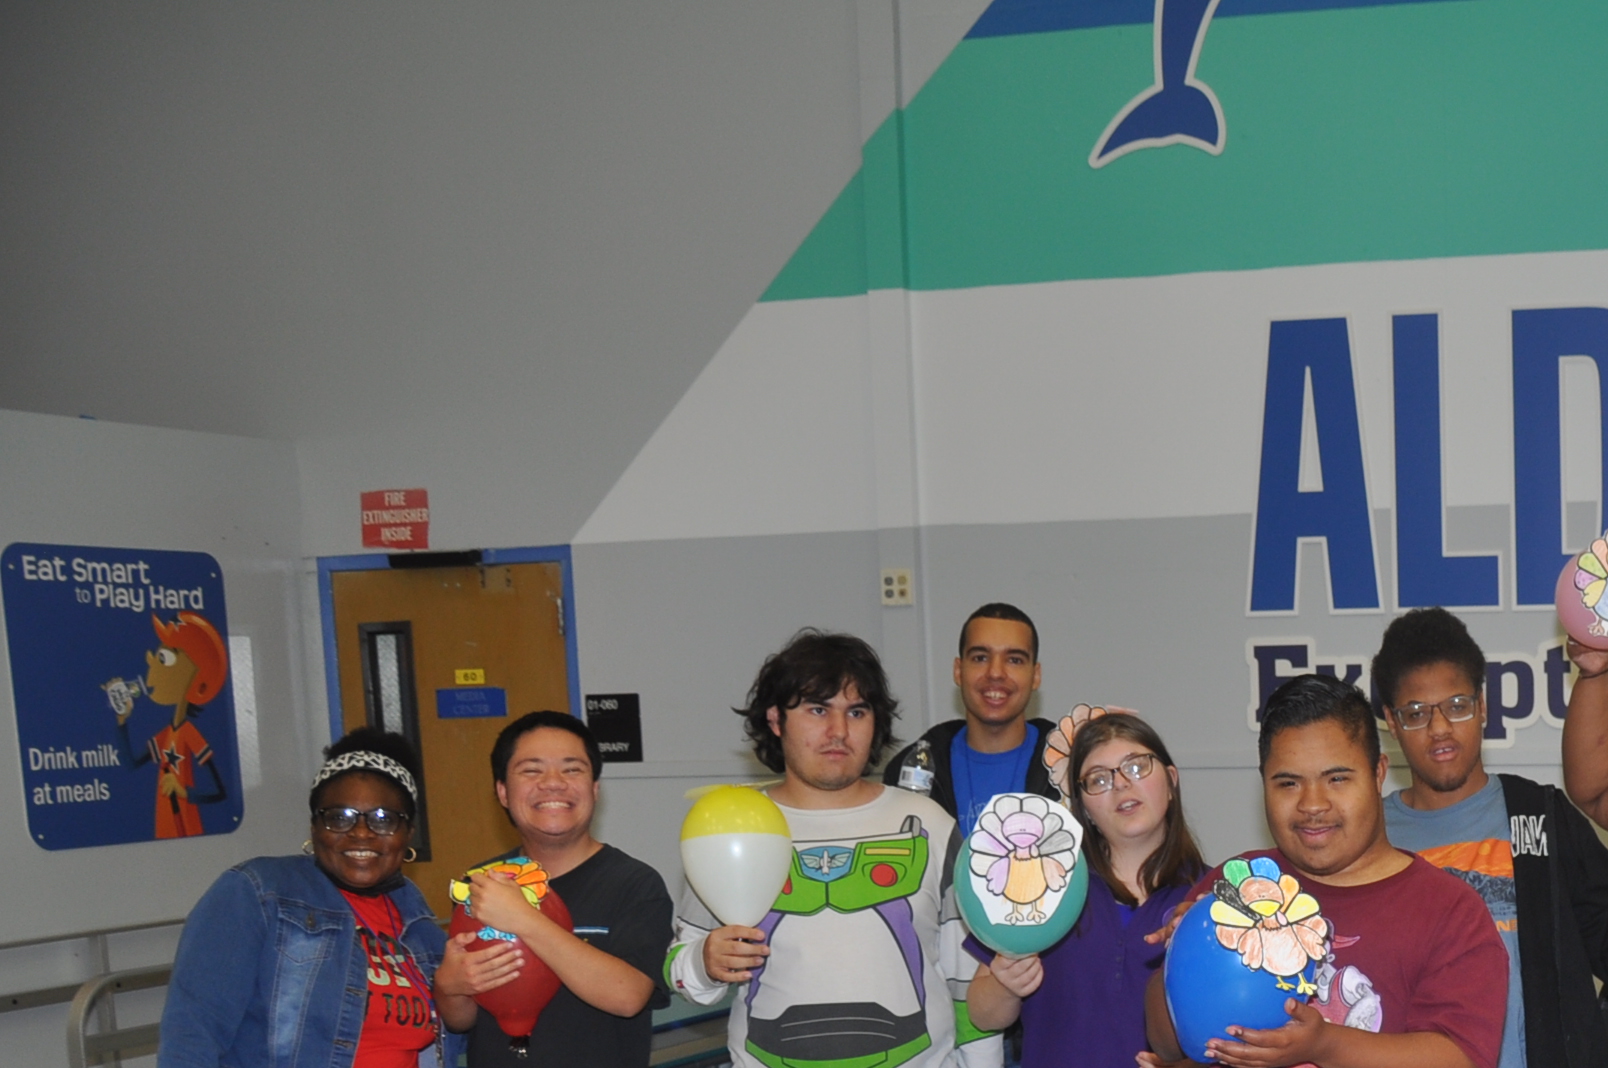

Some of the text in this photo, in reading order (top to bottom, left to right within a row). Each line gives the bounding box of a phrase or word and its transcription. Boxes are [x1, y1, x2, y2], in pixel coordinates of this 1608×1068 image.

[384, 491, 407, 506] FIRE
[362, 508, 429, 525] EXTINGUISHER
[381, 526, 413, 543] INSIDE
[21, 555, 151, 585] Eat Smart
[75, 583, 205, 613] to Play Hard
[463, 672, 478, 682] 60
[29, 744, 121, 772] Drink milk
[33, 778, 111, 806] at meals
